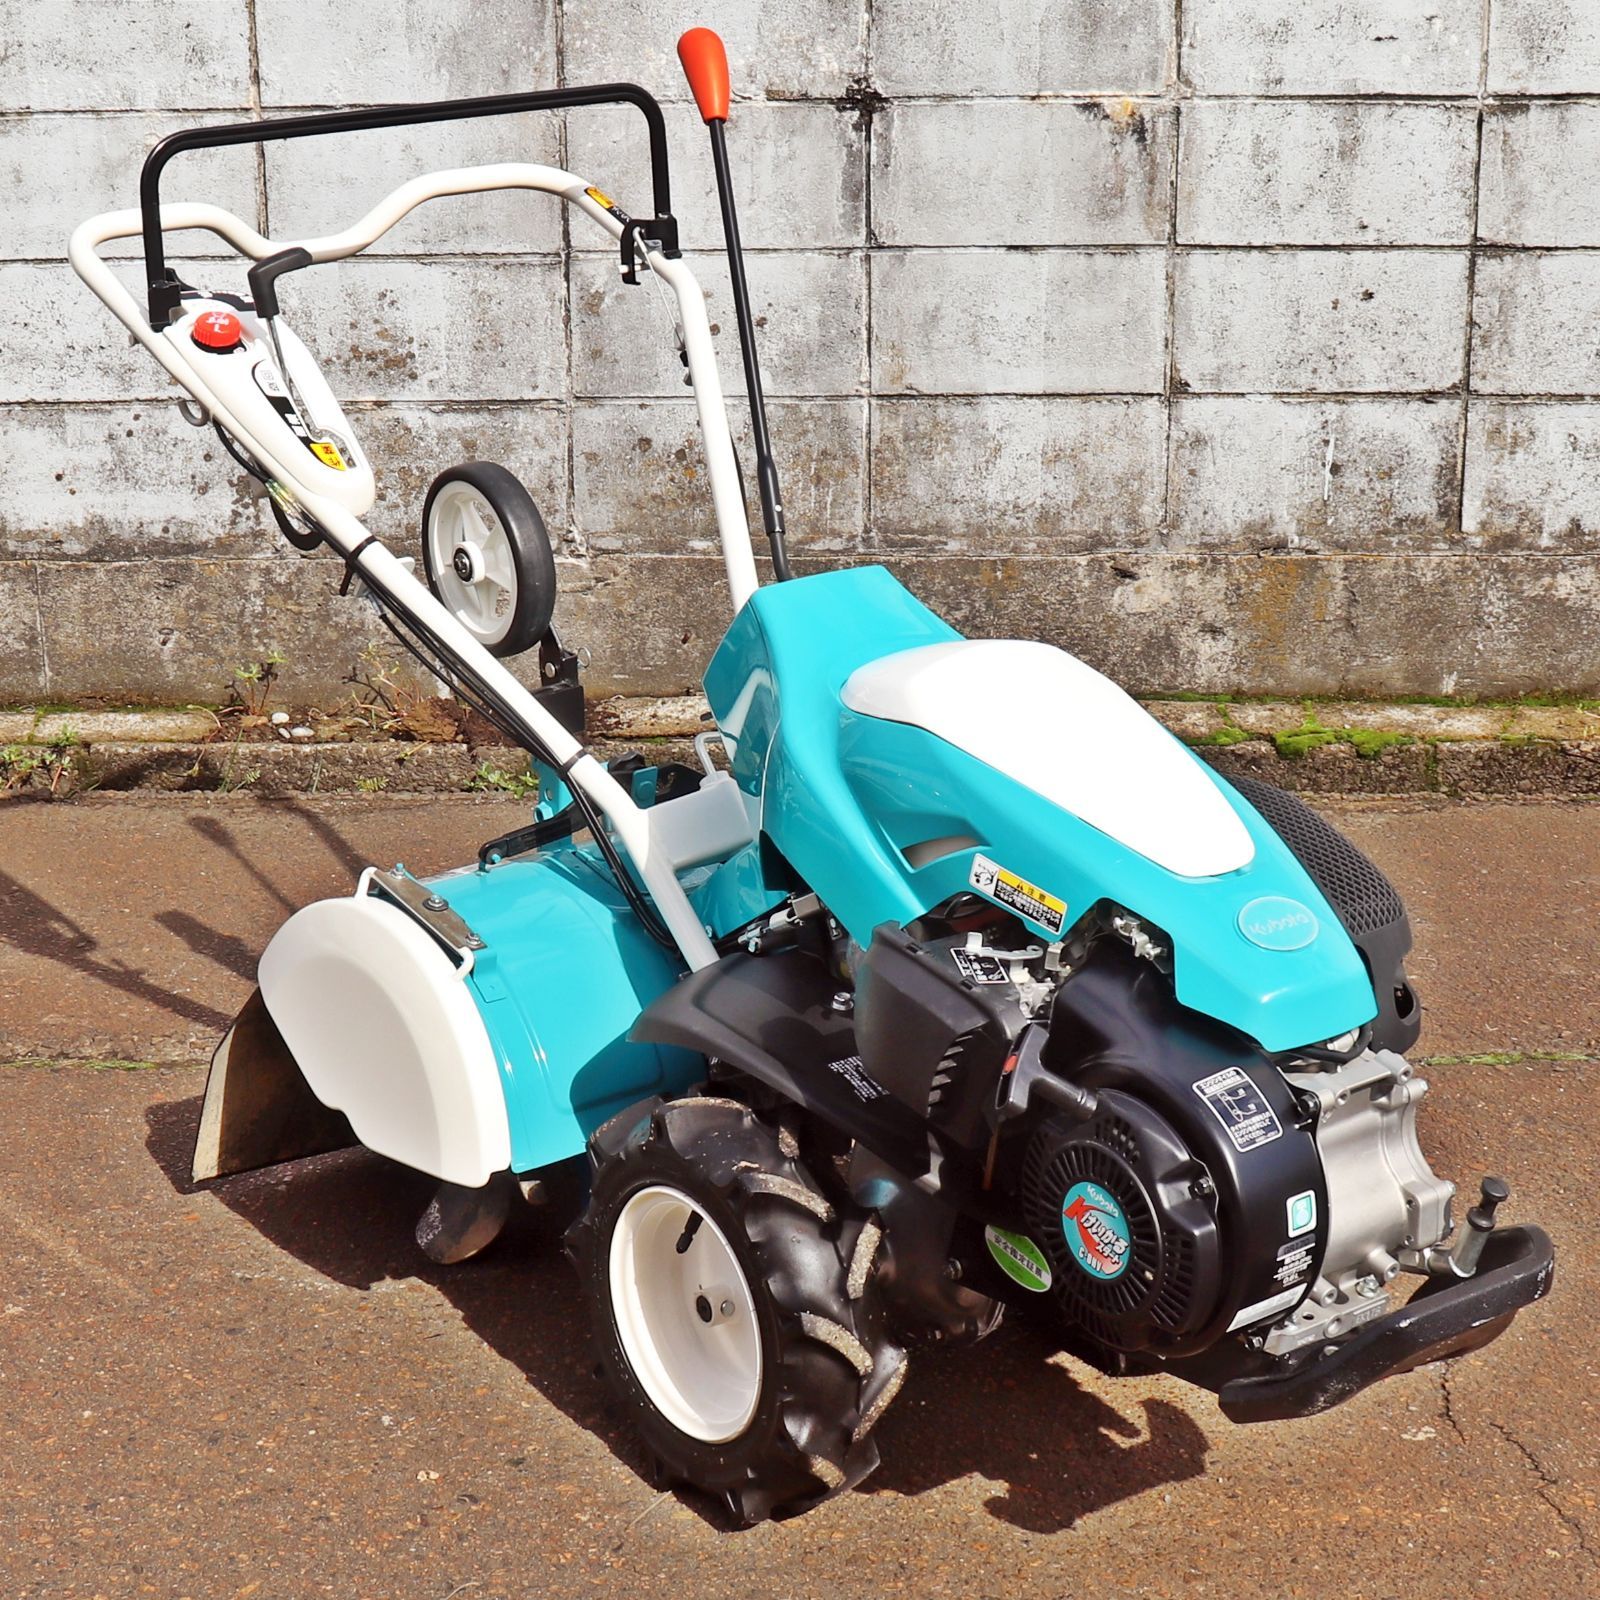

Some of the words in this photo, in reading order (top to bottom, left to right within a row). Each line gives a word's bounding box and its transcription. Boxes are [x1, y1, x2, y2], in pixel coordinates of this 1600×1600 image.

[1248, 912, 1310, 935] Kubota
[1087, 1184, 1119, 1218] Kubota
[1080, 1211, 1129, 1256] けいかる
